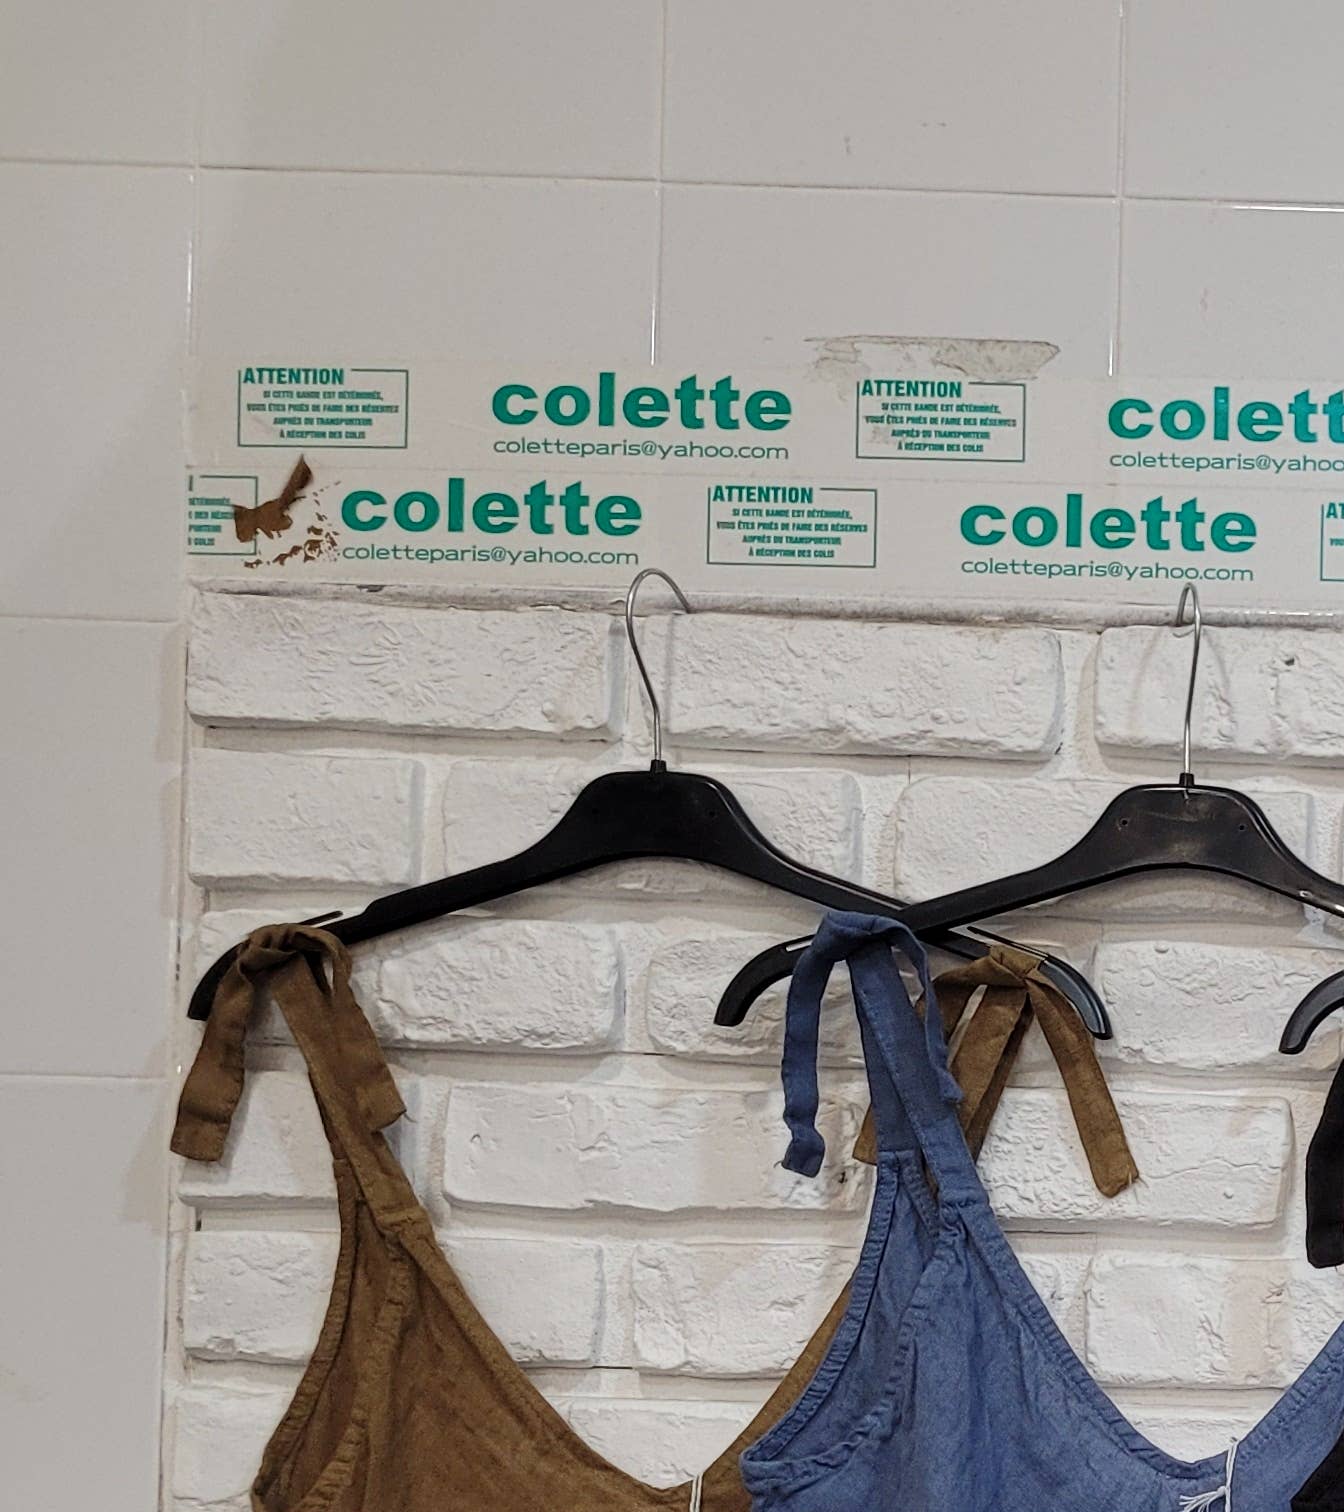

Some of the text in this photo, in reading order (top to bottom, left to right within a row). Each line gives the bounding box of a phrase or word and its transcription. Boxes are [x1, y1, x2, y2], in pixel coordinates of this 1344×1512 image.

[243, 367, 344, 385] ATTENTION
[861, 379, 962, 398] ATTENTION
[492, 371, 792, 431] colette
[493, 436, 789, 461] coletteparis@yahoo.com
[712, 485, 813, 504] ATTENTION
[341, 477, 642, 537] colette
[960, 493, 1257, 553] colette
[342, 543, 639, 565] coletteparis@yahoo.com
[961, 557, 1254, 581] coletteparis@yahoo.com
